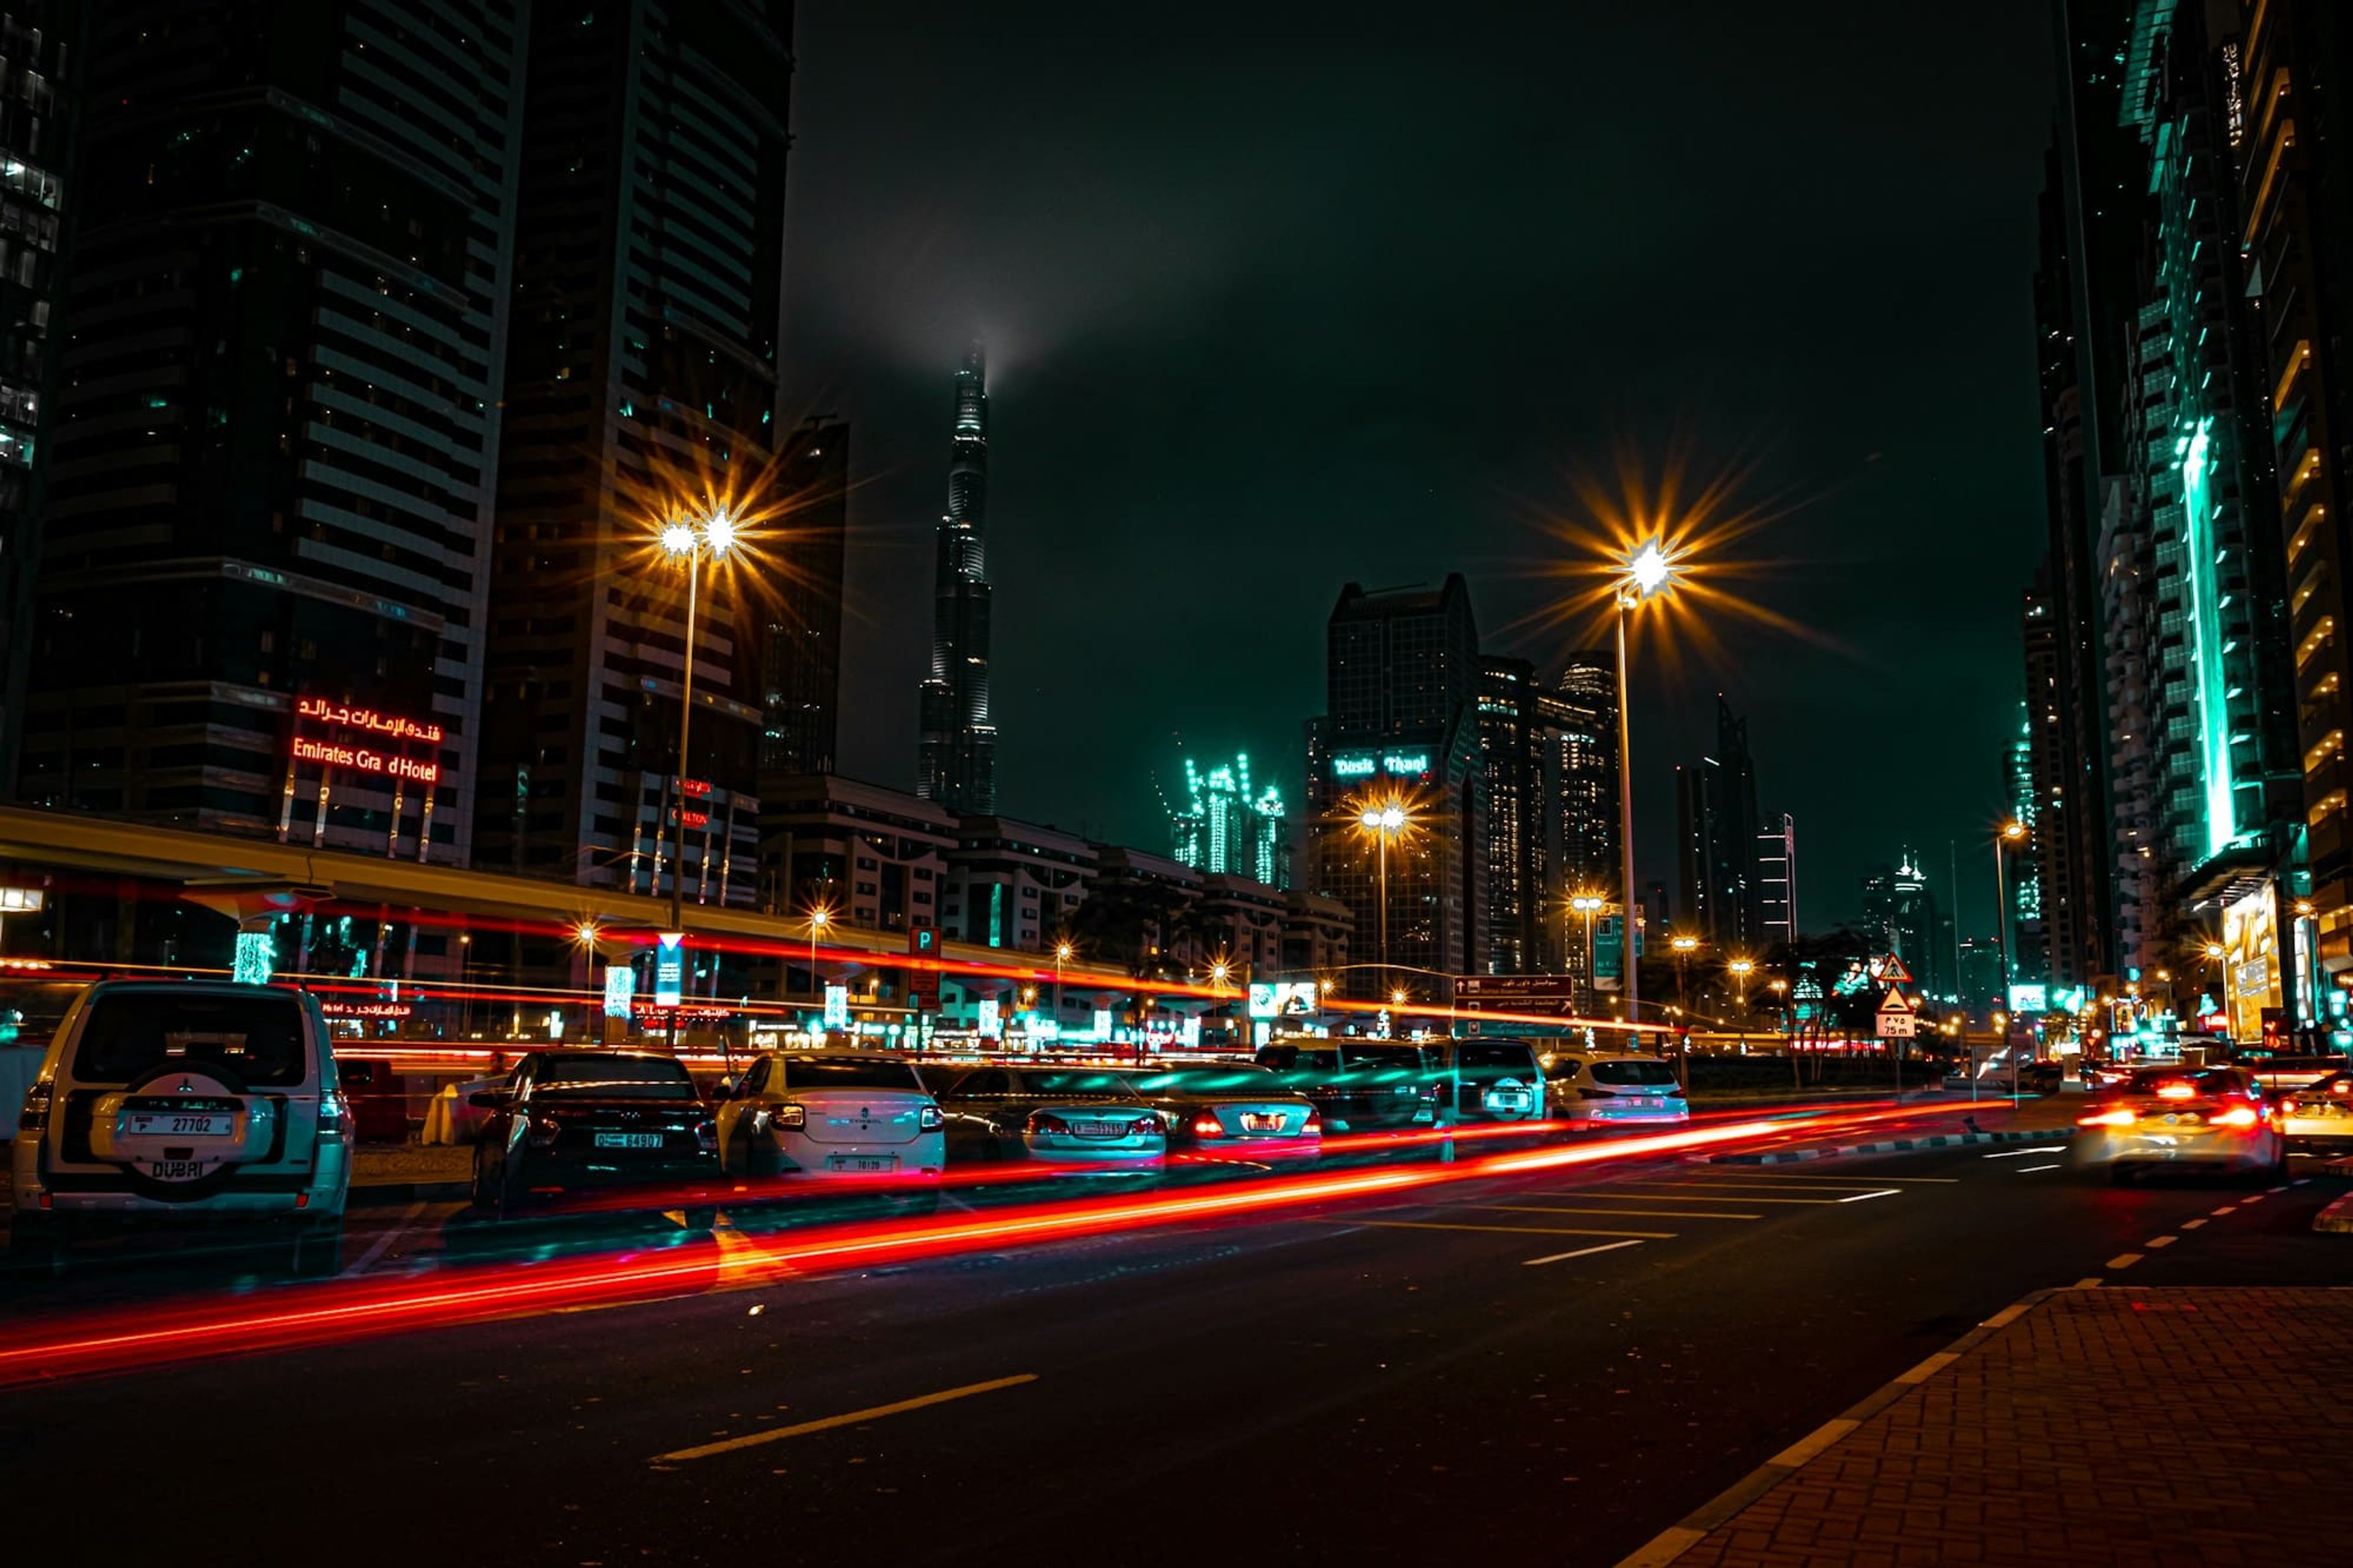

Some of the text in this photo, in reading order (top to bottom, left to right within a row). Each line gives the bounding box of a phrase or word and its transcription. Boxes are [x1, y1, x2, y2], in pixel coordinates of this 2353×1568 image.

[294, 737, 436, 782] Emirates Grad Hotel
[1334, 757, 1376, 775] Dusit
[920, 931, 931, 949] P
[1885, 1026, 1897, 1035] 75
[172, 1118, 211, 1132] 27702
[626, 1135, 661, 1148] 64907
